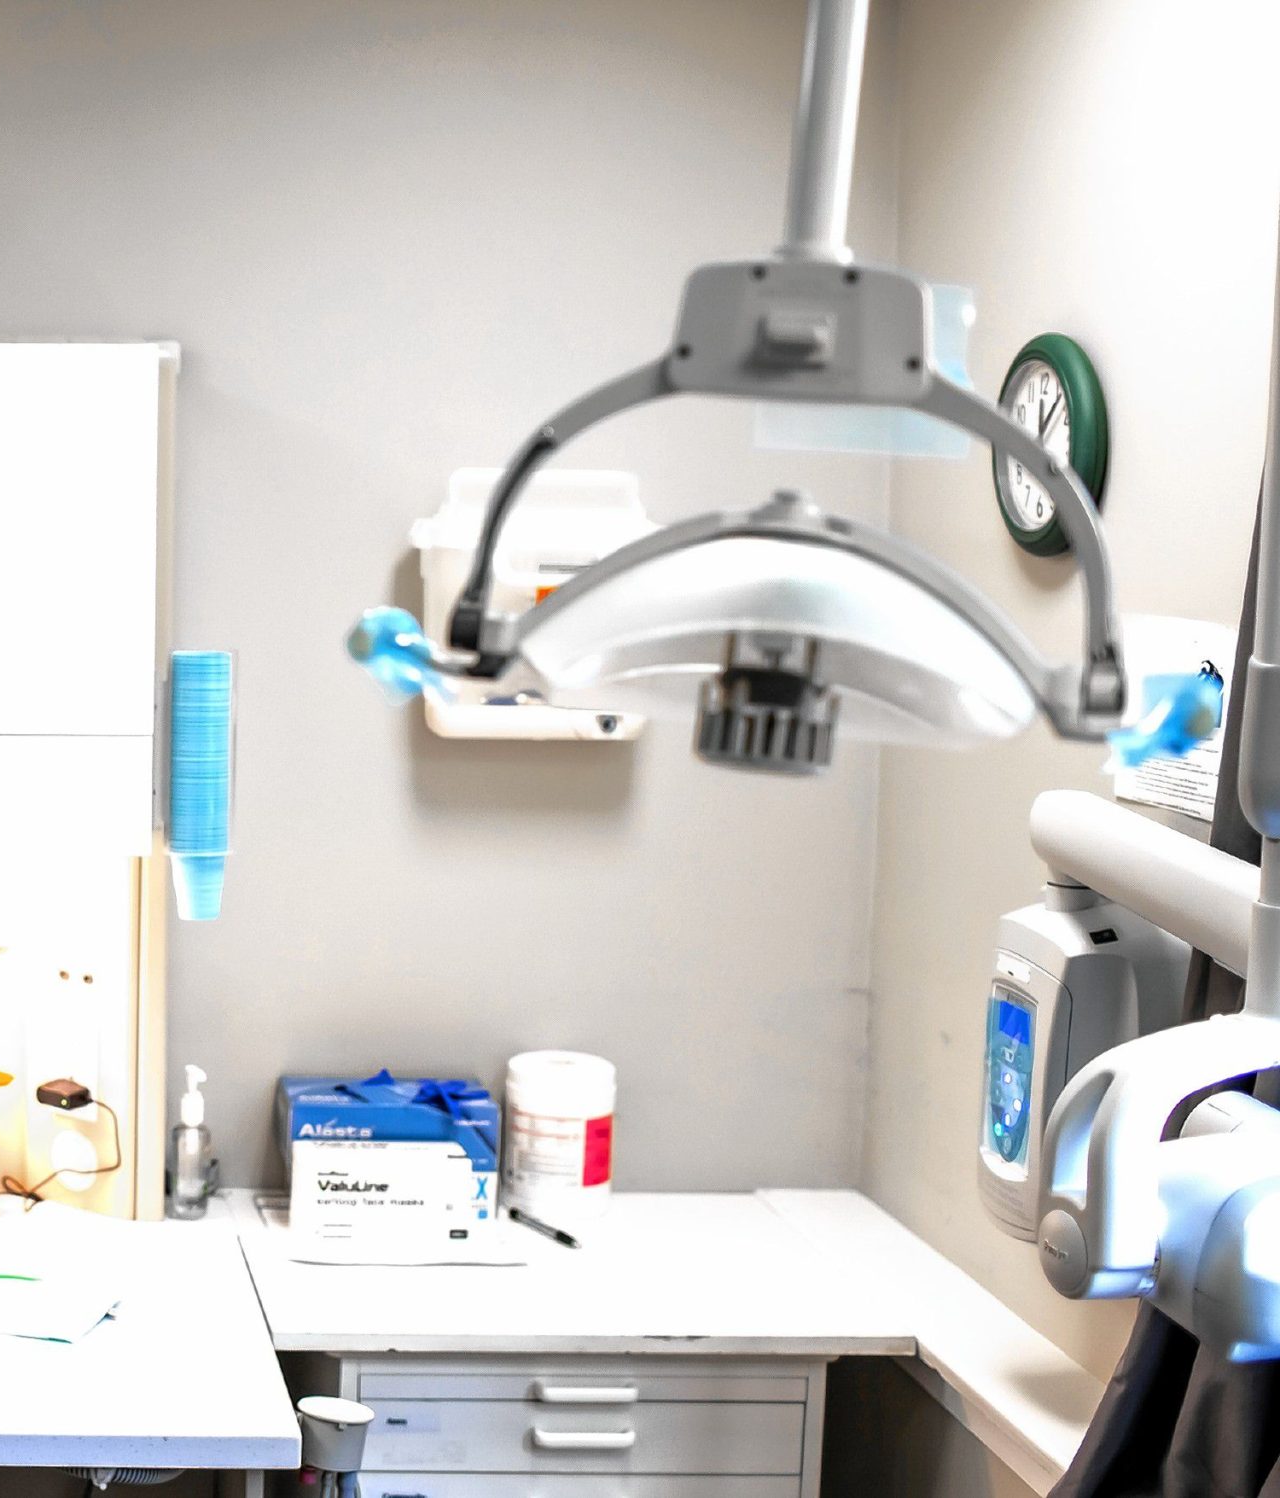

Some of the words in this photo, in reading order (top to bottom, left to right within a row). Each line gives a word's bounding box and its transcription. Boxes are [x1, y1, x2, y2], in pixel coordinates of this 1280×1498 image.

[1028, 381, 1035, 403] 11
[1040, 372, 1050, 395] 12
[1016, 462, 1023, 485] 8
[1025, 484, 1031, 508] 7
[1036, 494, 1043, 518] 6
[317, 1179, 389, 1193] ValuLine
